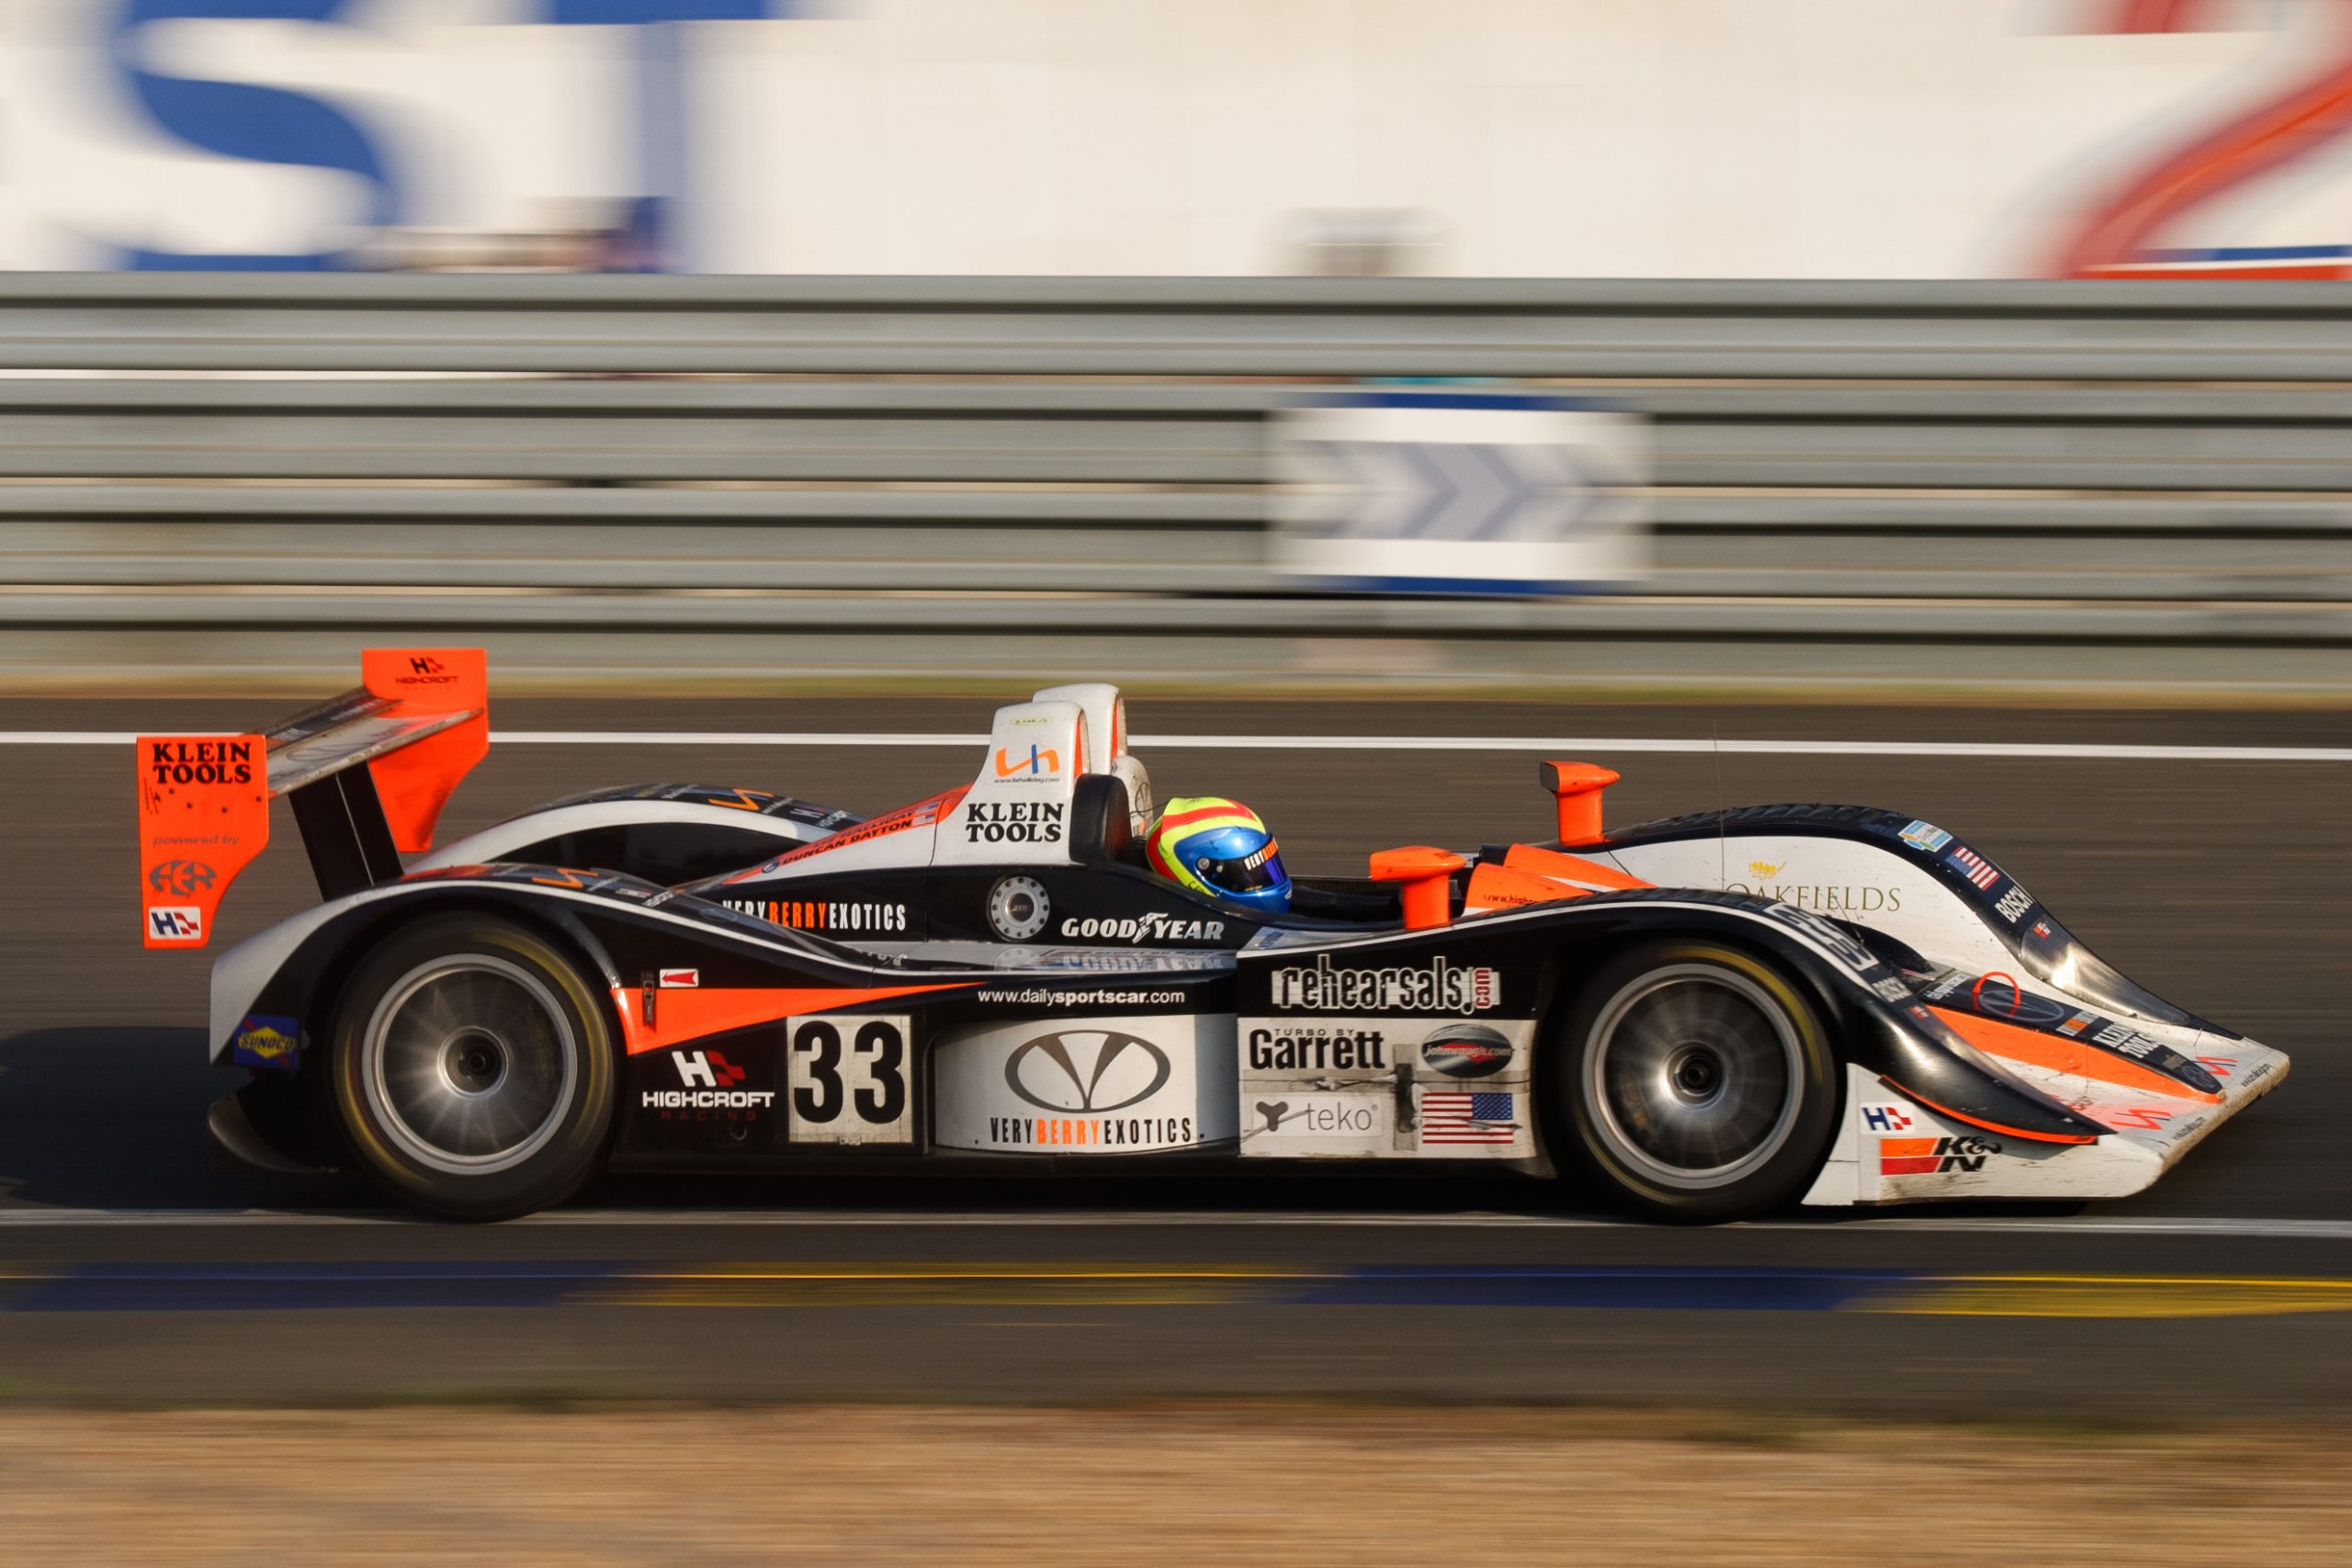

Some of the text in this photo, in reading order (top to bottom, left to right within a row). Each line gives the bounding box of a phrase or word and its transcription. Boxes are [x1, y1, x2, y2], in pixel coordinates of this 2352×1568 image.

[153, 742, 250, 762] KLEIN
[153, 764, 251, 784] TOOLS
[967, 803, 1064, 822] KLEIN
[783, 839, 845, 864] DUNCAN
[850, 820, 912, 844] DAYTON
[966, 823, 1061, 842] TOOLS
[1995, 886, 2033, 923] BOSCH
[978, 988, 1185, 1007] www.dailysportscar.com
[1274, 1028, 1354, 1036] TURBO BY
[1250, 1029, 1385, 1069] Garrett
[794, 1021, 906, 1124] 33
[642, 1091, 775, 1108] HIGHCROFT
[662, 1111, 756, 1121] RACING
